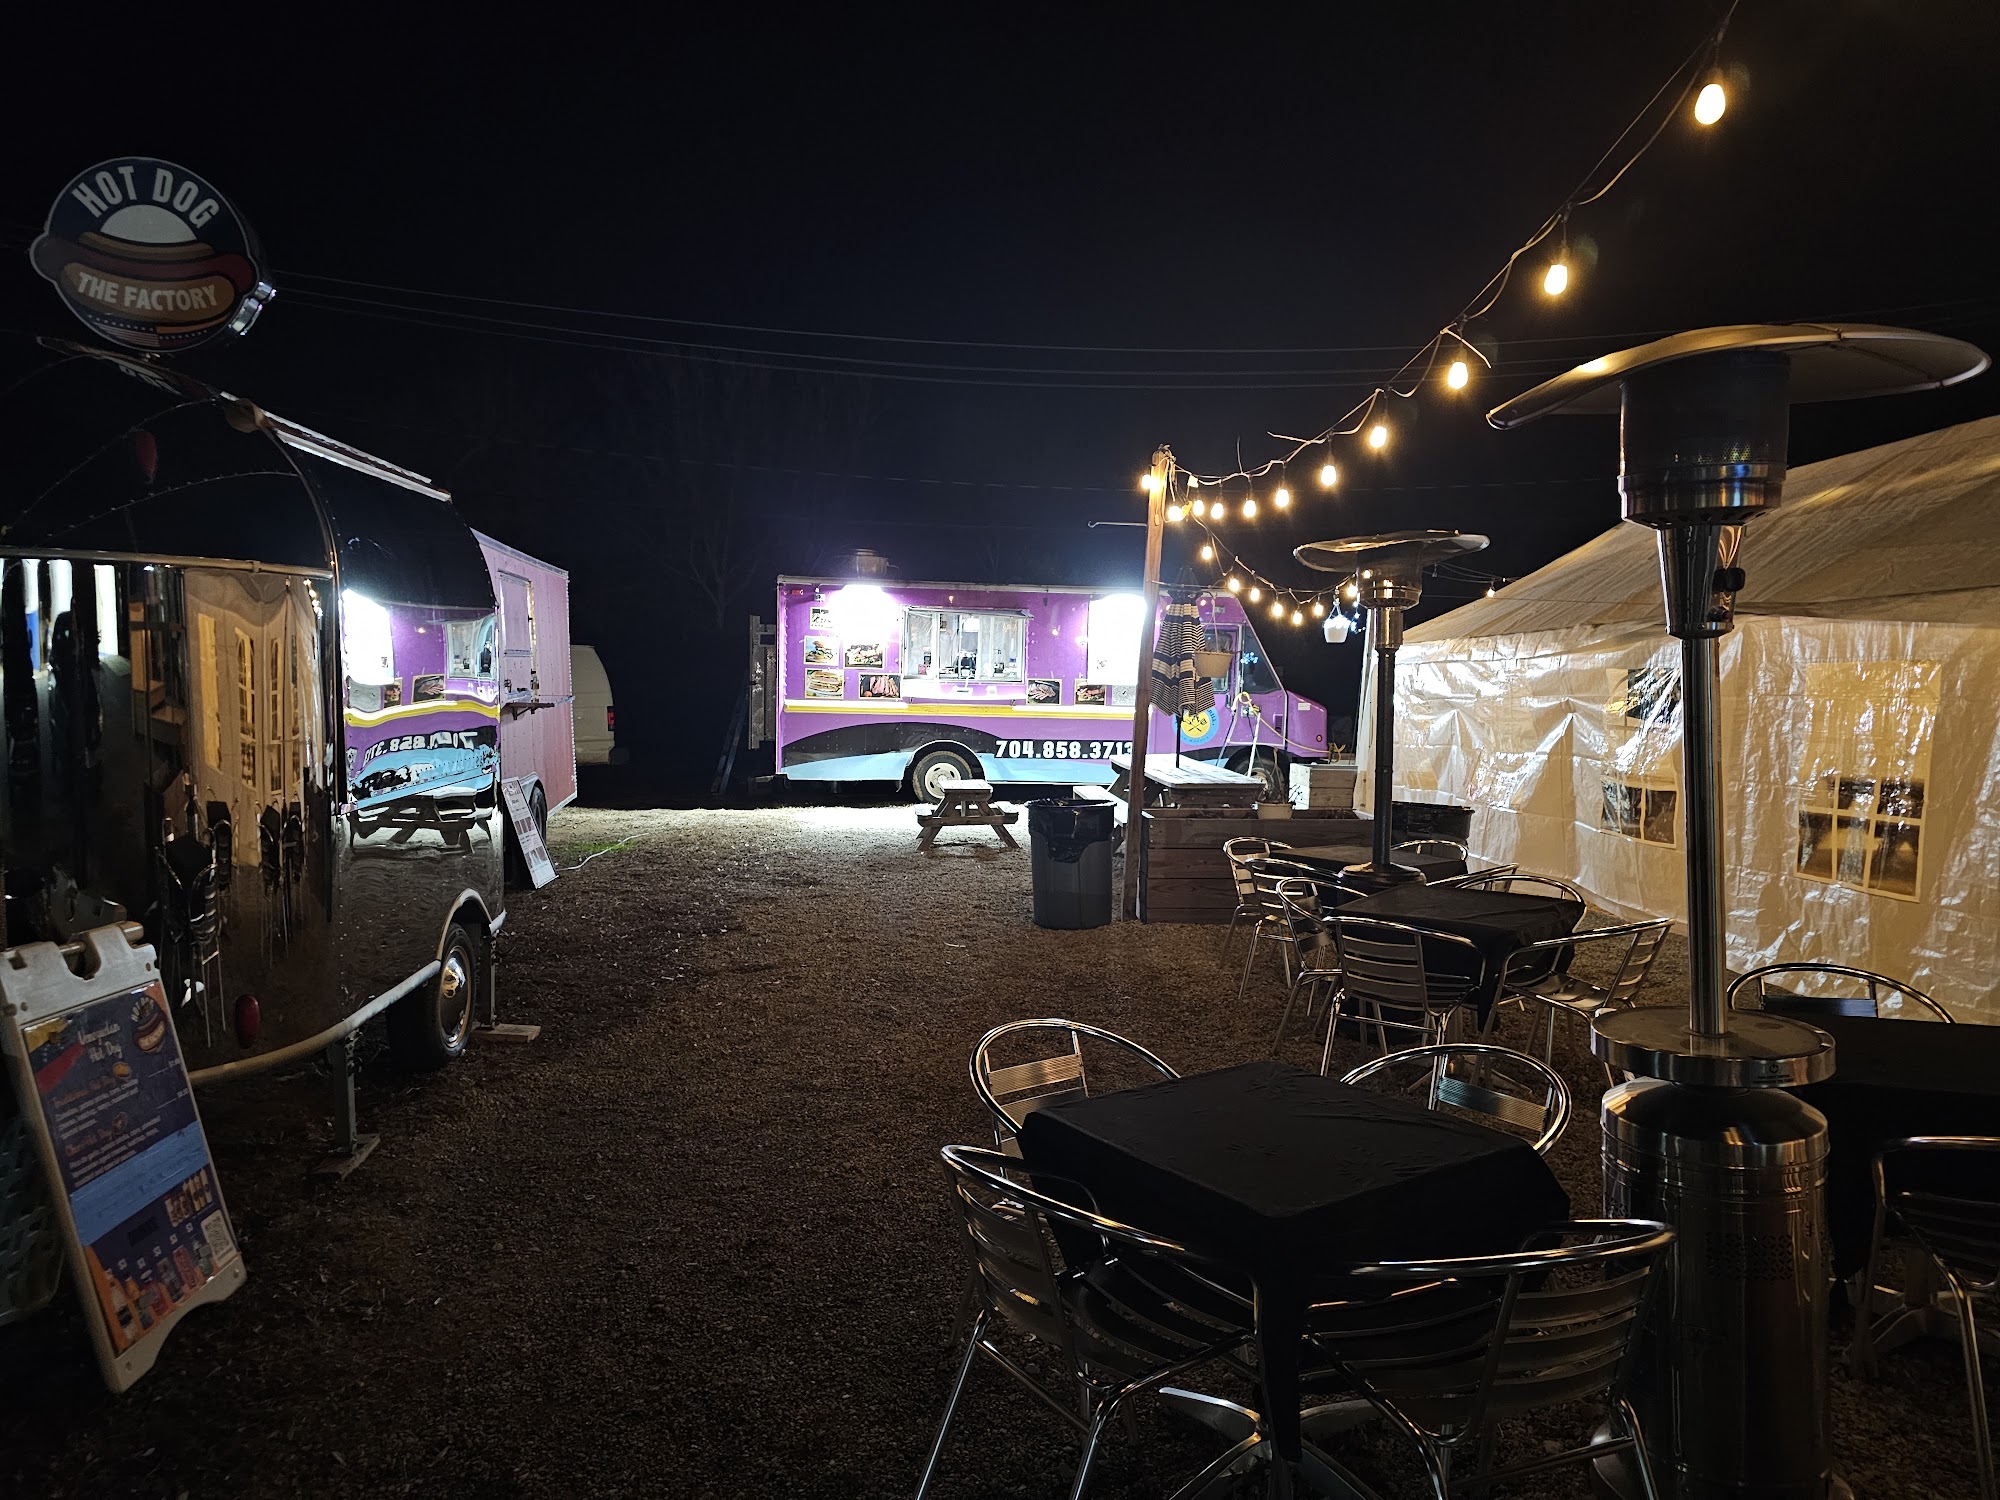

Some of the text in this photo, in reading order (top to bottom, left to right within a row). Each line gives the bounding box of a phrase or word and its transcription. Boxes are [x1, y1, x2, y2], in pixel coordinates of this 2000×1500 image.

[72, 166, 219, 229] HOT DOG
[78, 271, 218, 311] THE FACTORY
